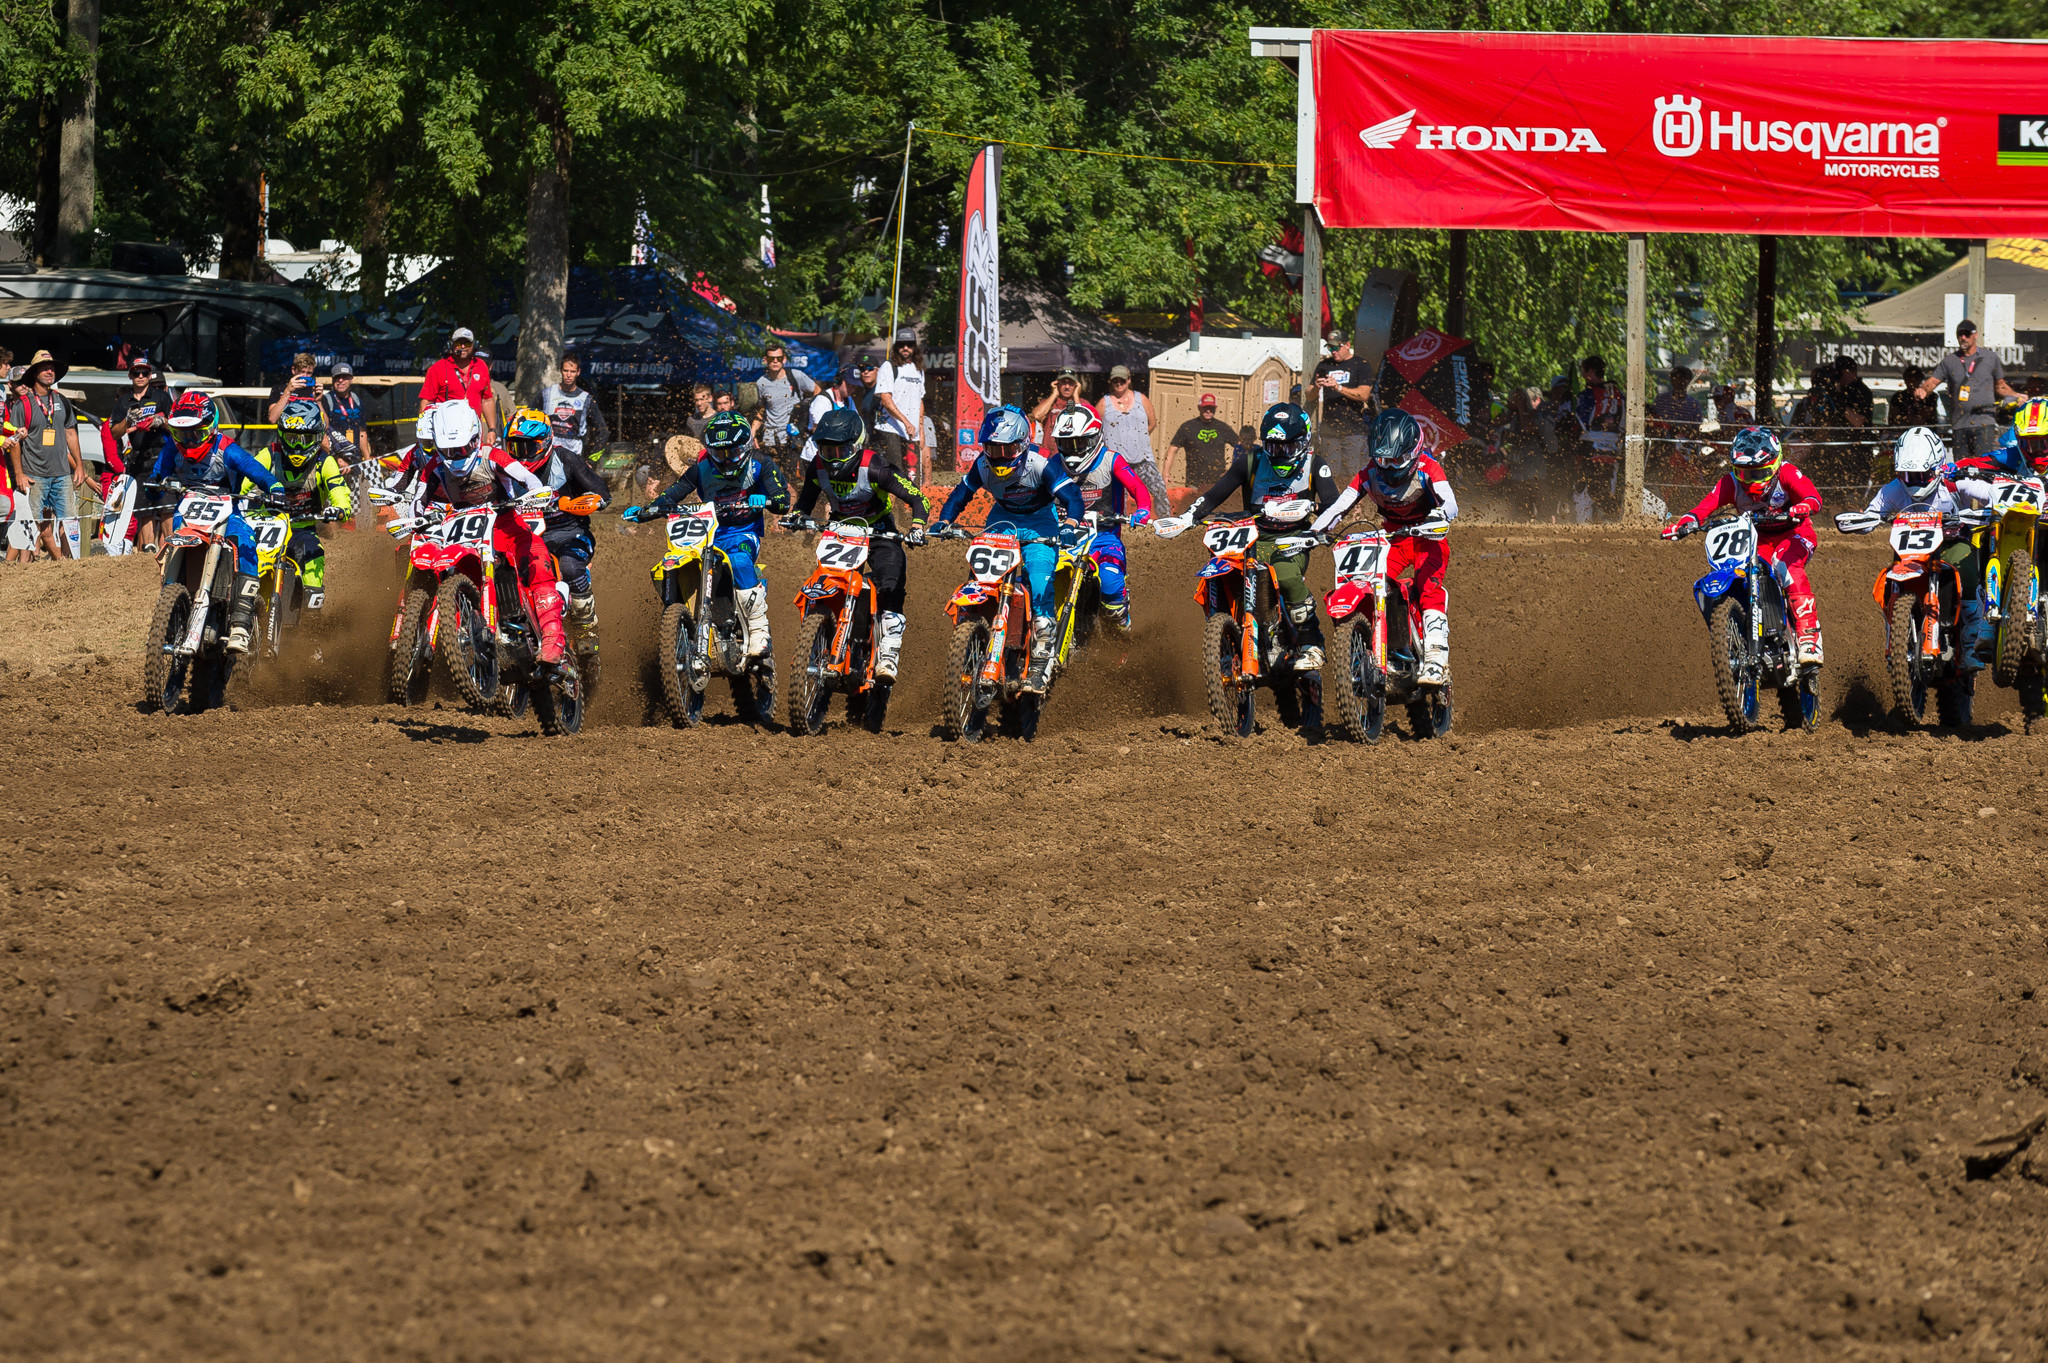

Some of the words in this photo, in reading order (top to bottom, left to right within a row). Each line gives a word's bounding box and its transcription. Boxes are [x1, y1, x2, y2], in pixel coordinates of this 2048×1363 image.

[1416, 126, 1606, 152] HONDA
[1825, 163, 1939, 178] MOTORCYCLES
[964, 210, 989, 402] SSR
[183, 501, 225, 522] 85
[446, 515, 488, 543] 49
[1210, 528, 1250, 552] 34
[1898, 530, 1935, 551] 13
[820, 543, 863, 567] 24
[1712, 529, 1750, 560] 28
[970, 548, 1014, 575] 63
[1339, 546, 1382, 573] 47
[267, 605, 275, 641] DUNLO
